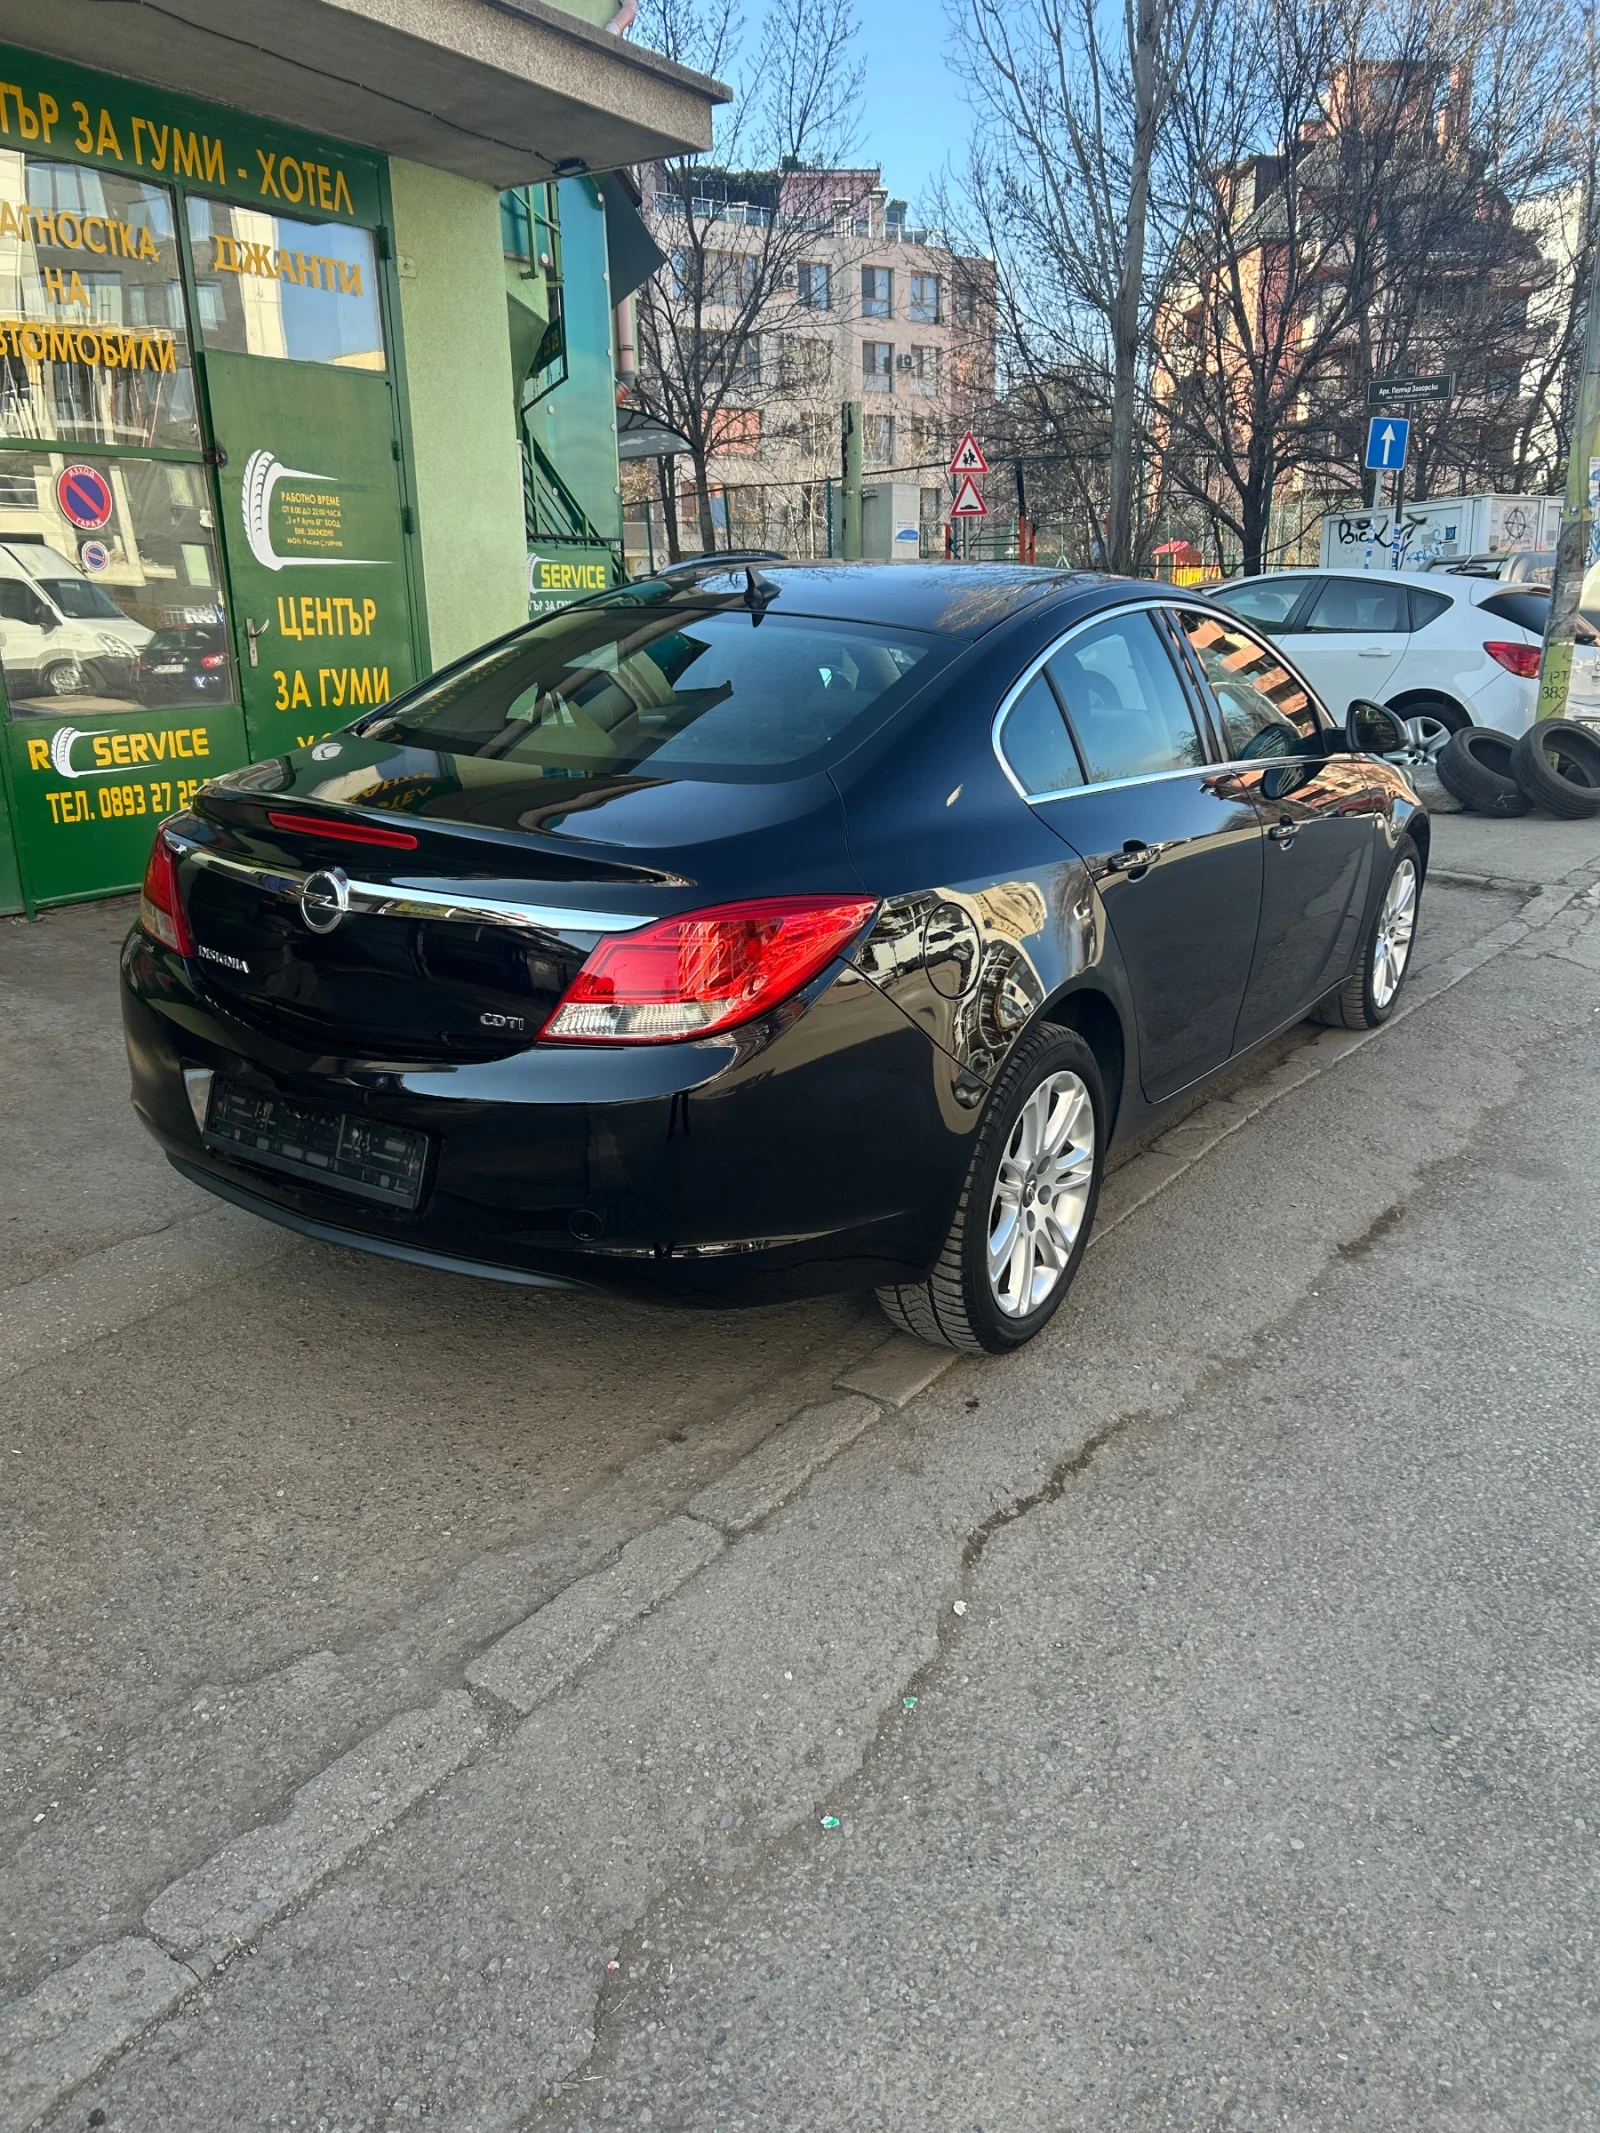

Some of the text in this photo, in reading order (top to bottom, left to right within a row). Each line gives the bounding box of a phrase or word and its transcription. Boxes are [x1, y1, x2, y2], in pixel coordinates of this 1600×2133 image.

[72, 100, 124, 161] ЗА
[131, 116, 226, 186] ГУМИ
[256, 148, 355, 216] ХОТЕЛ
[0, 200, 160, 263] АГНОСТКА
[213, 234, 364, 296] ДЖАНТИ
[44, 266, 91, 308] НА
[68, 467, 95, 479] ИЗХОД
[281, 491, 340, 506] РАБОТНО ВРЕМЕ
[76, 517, 103, 528] ГАРАЖ
[325, 518, 341, 528] ЕООД
[541, 563, 606, 588] SERVICE
[277, 596, 377, 641] ЦЕНТЪР
[273, 667, 390, 711] ЗА ГУМИ
[1542, 686, 1566, 699] 383
[93, 728, 210, 766] SERVICE
[46, 791, 96, 824] ТЕЛ.
[98, 785, 146, 819] 0893
[150, 782, 172, 813] 27
[198, 945, 250, 974] INSIGNIA
[480, 1012, 524, 1031] CDTI
